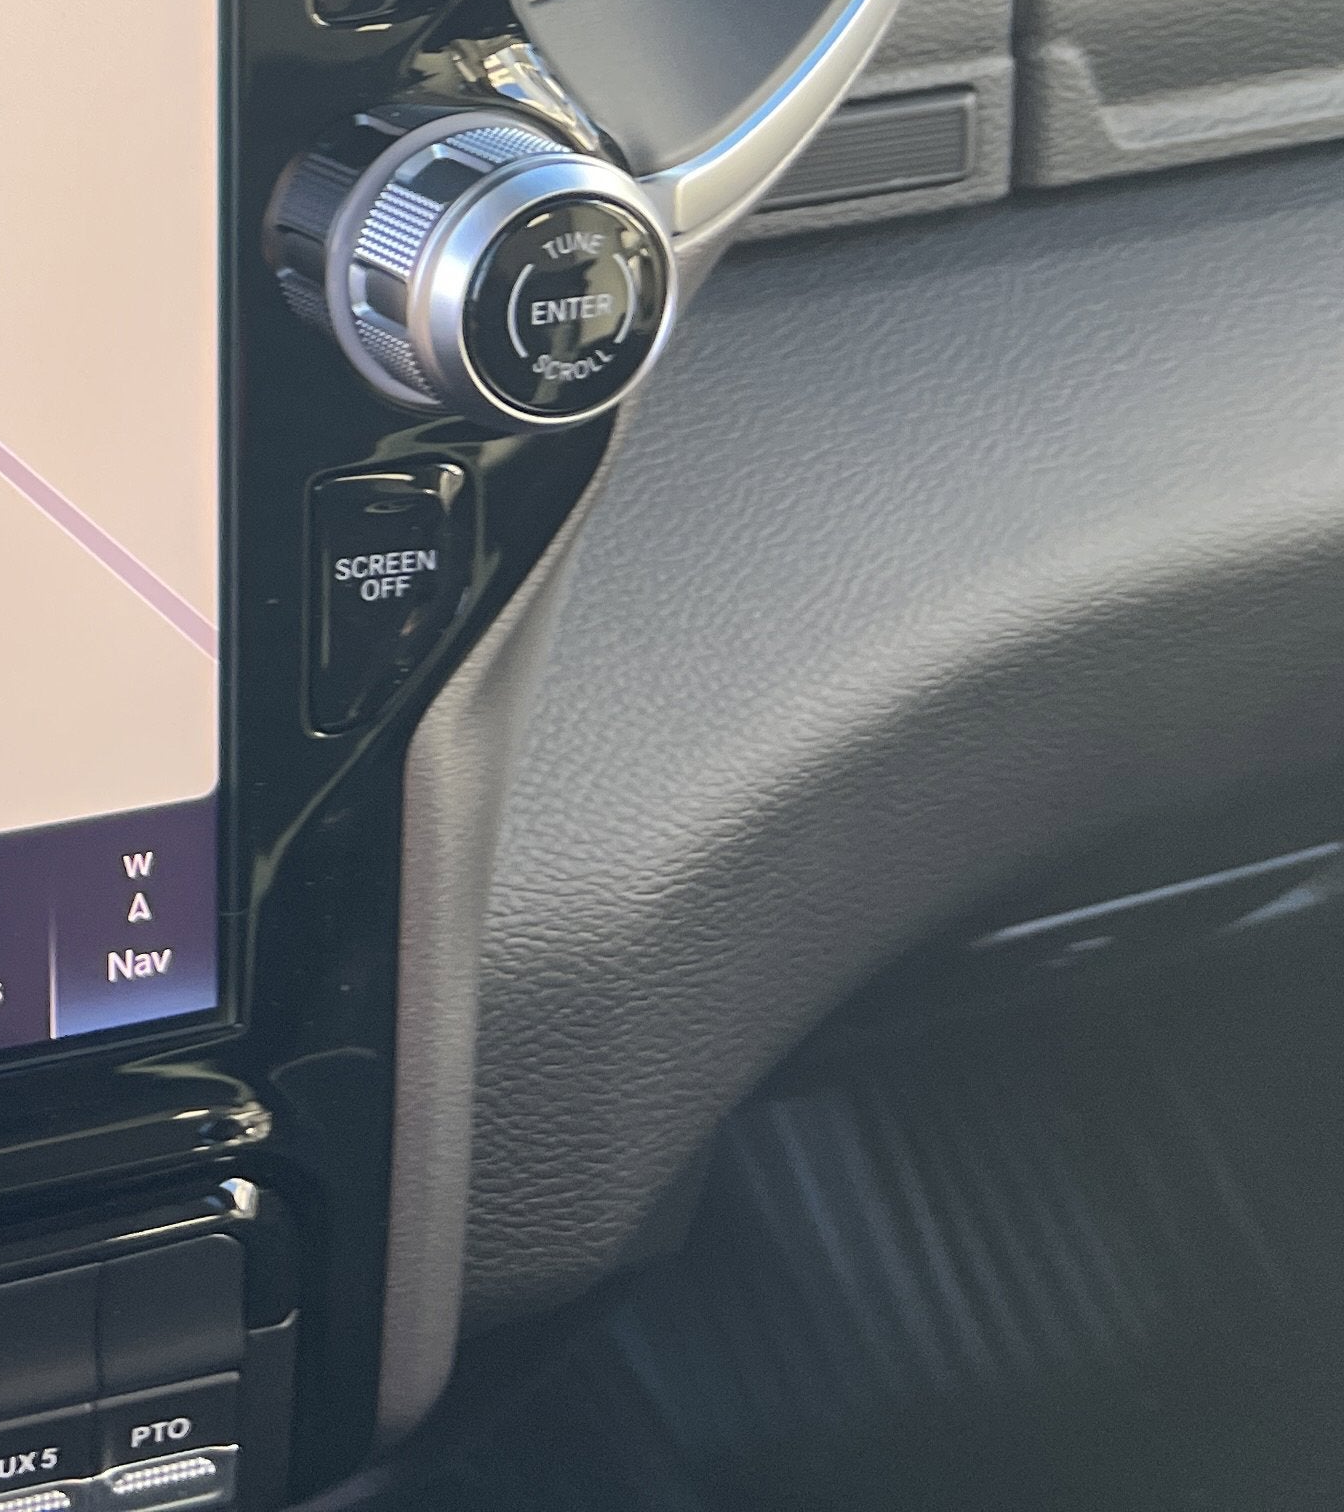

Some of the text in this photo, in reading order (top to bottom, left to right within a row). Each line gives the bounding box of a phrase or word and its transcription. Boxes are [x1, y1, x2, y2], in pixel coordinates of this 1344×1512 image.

[541, 234, 606, 260] TUNE
[530, 293, 612, 324] ENTER
[532, 350, 614, 382] SCROLL
[335, 550, 436, 580] SCREEN
[360, 575, 410, 601] OFF
[123, 851, 153, 879] W
[107, 947, 172, 983] Nav
[130, 1417, 193, 1448] PTO
